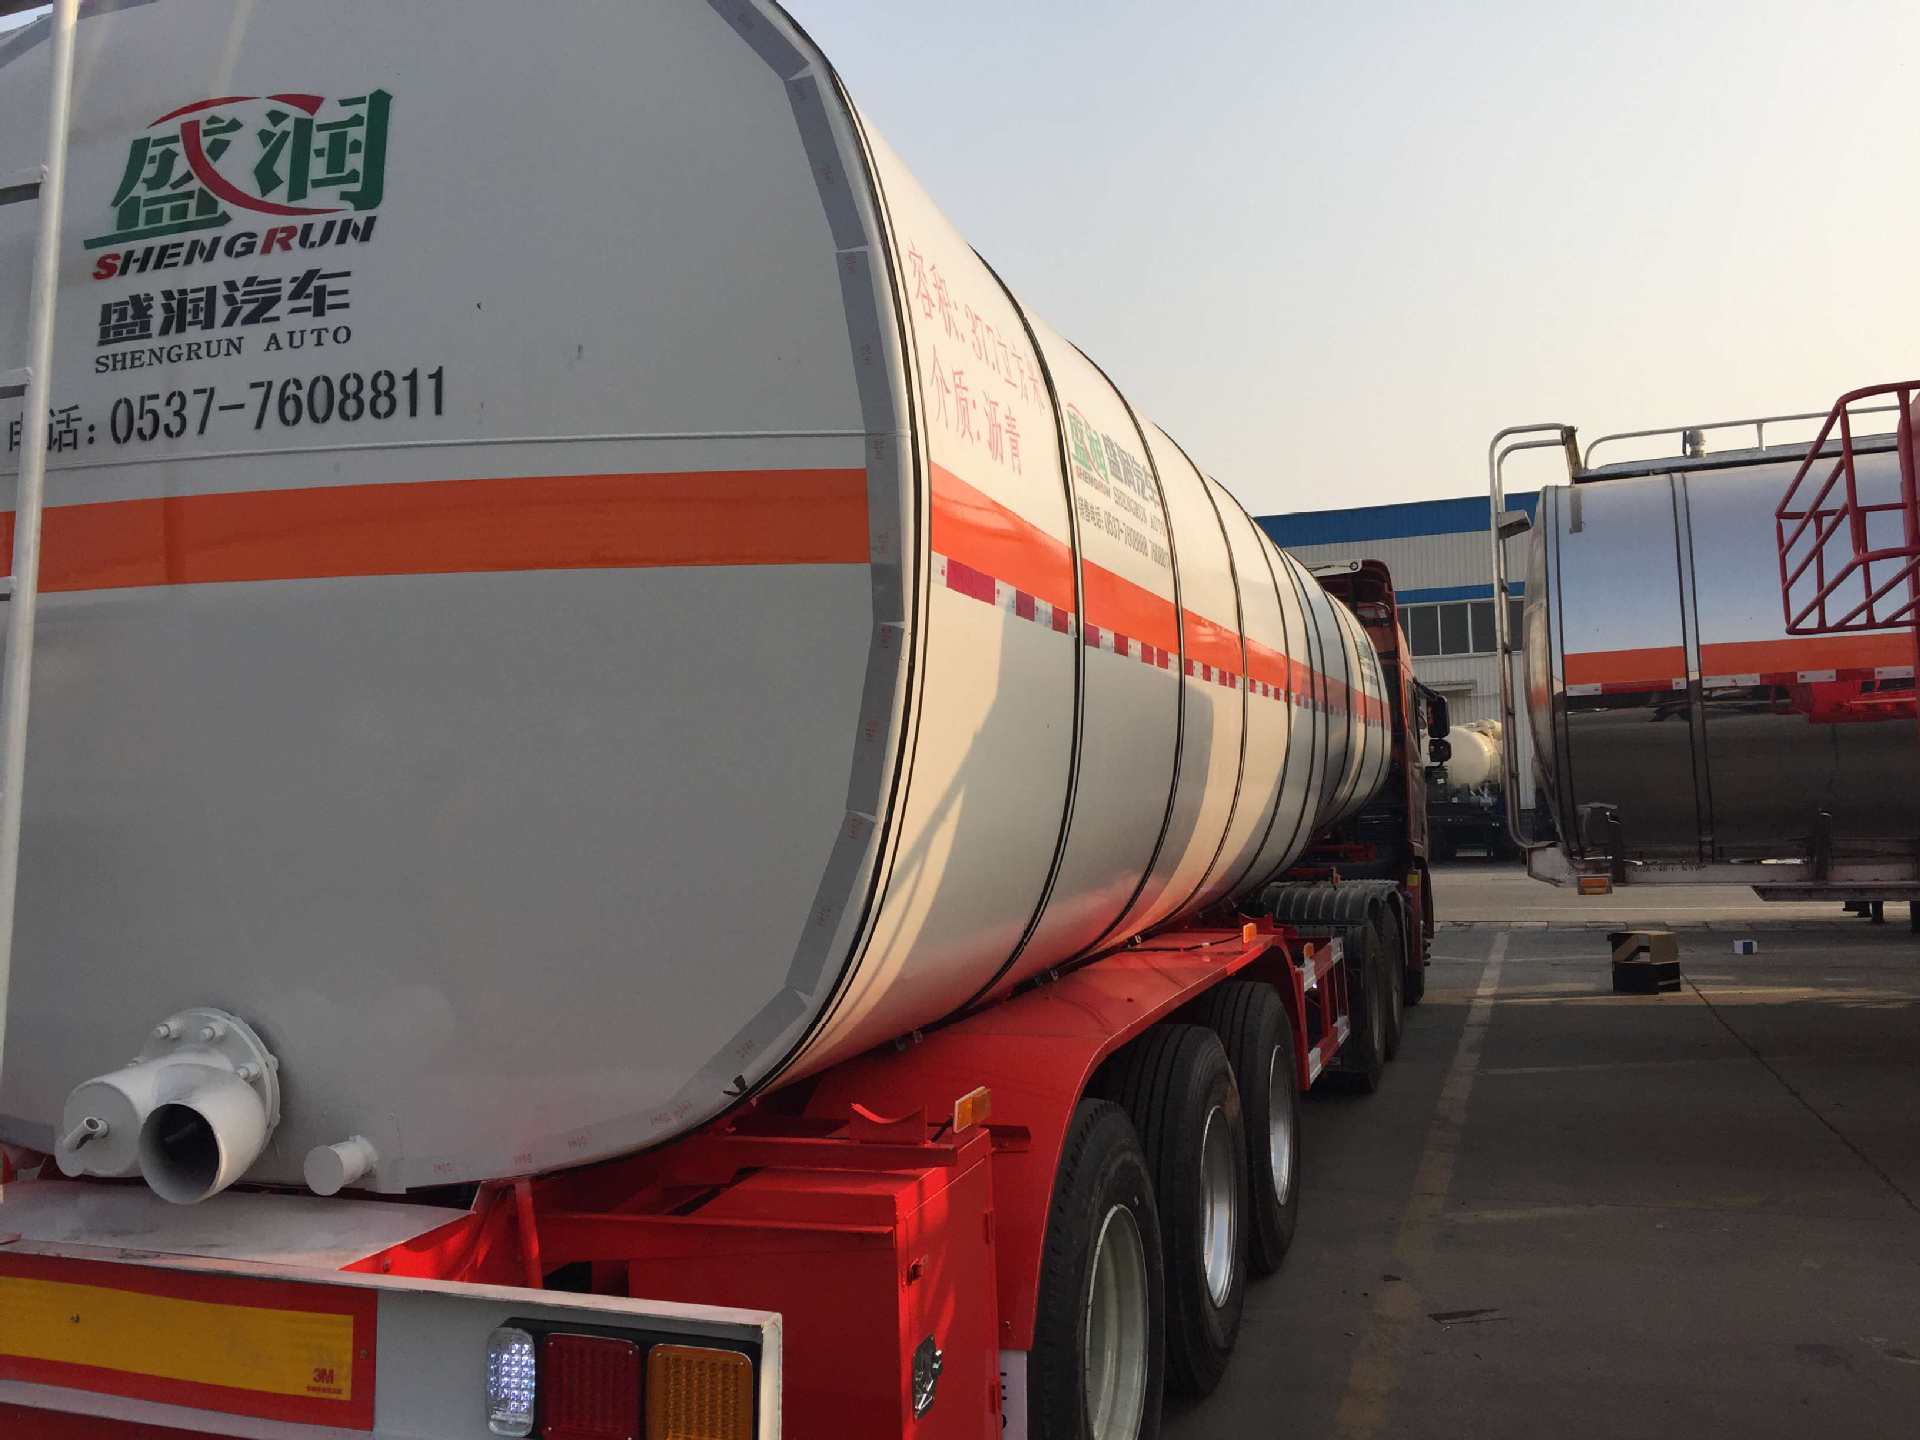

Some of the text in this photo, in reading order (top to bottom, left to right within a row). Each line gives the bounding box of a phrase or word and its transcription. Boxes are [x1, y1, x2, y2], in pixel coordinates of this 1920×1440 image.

[83, 89, 393, 249] 盛润
[92, 216, 377, 280] SHENGRUN
[97, 269, 352, 347] 盛润汽车
[95, 325, 352, 374] SHENGRUN AUTO
[313, 1367, 334, 1384] 3M
